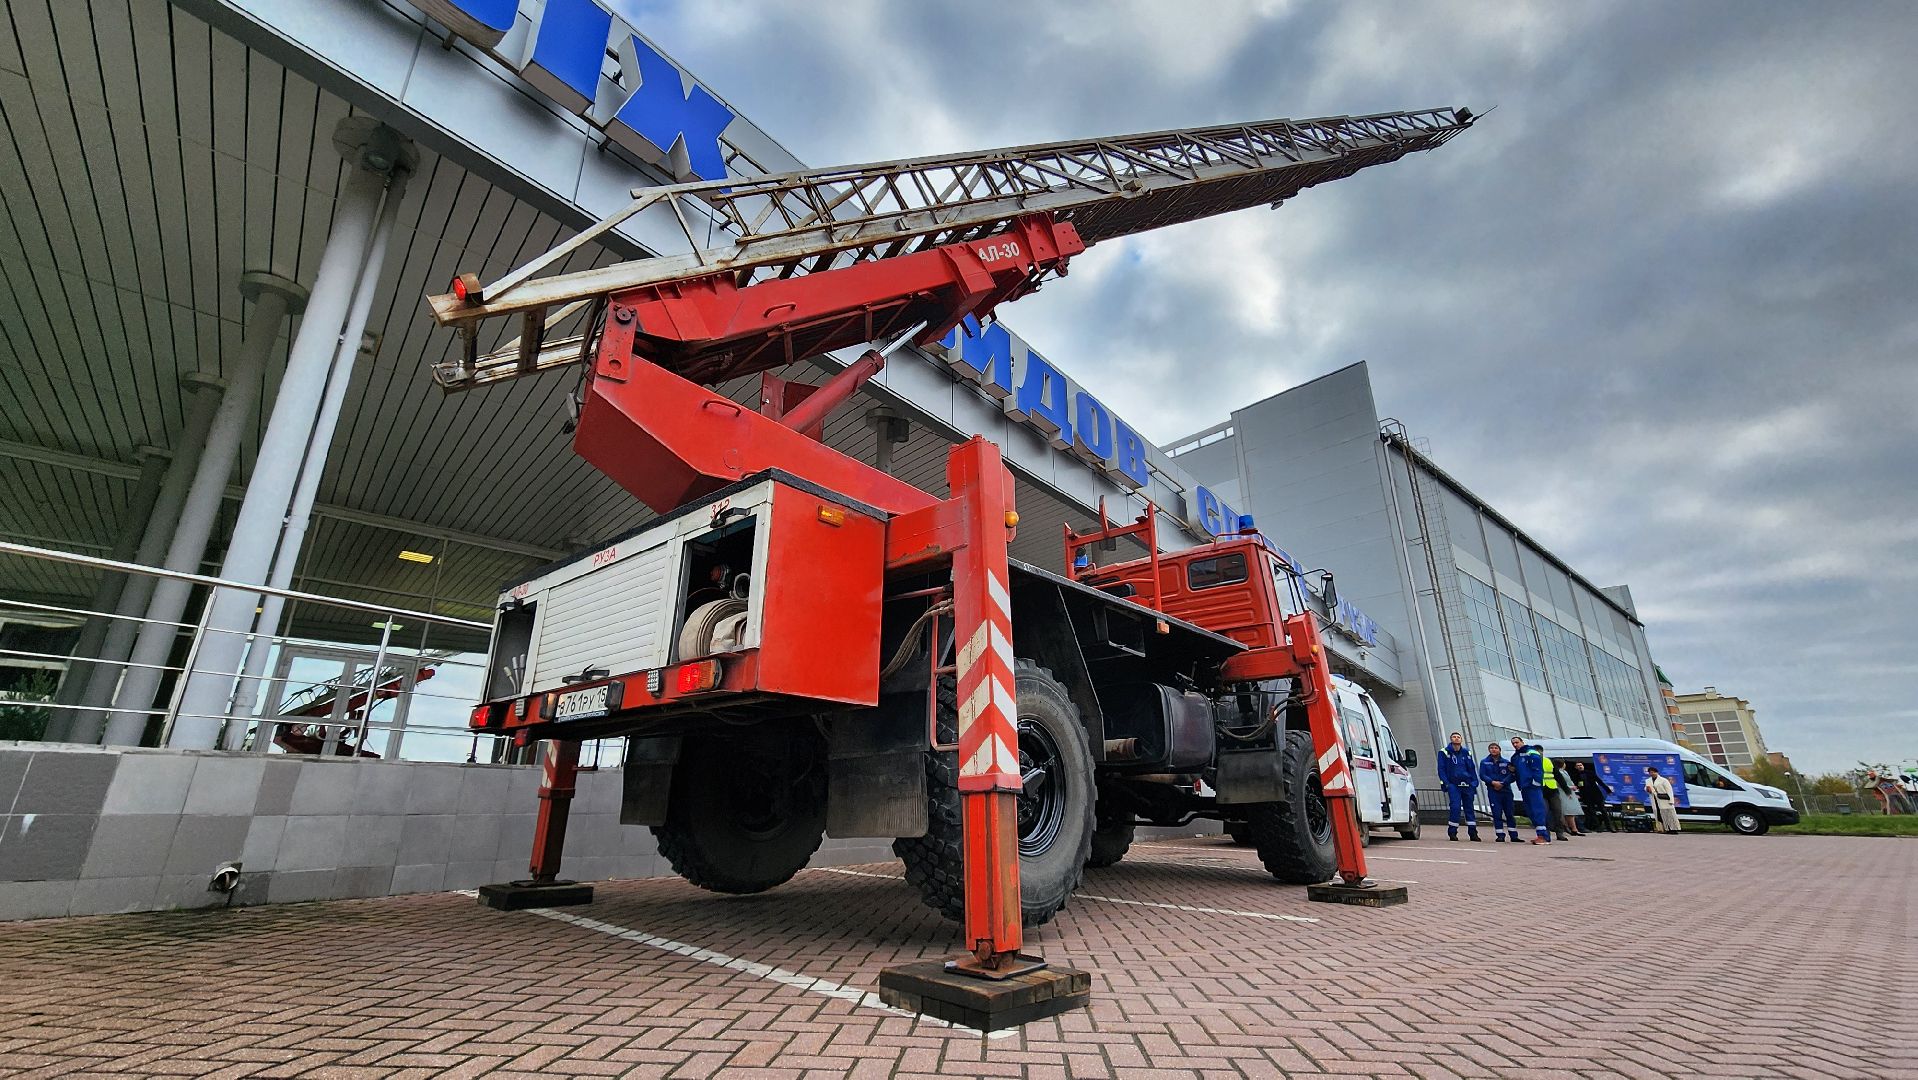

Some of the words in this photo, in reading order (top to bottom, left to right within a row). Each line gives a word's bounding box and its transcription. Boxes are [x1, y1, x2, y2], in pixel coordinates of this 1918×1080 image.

[978, 242, 1020, 262] АЛ-30
[939, 312, 1148, 487] ИДОВ
[593, 547, 616, 568] РУЗА
